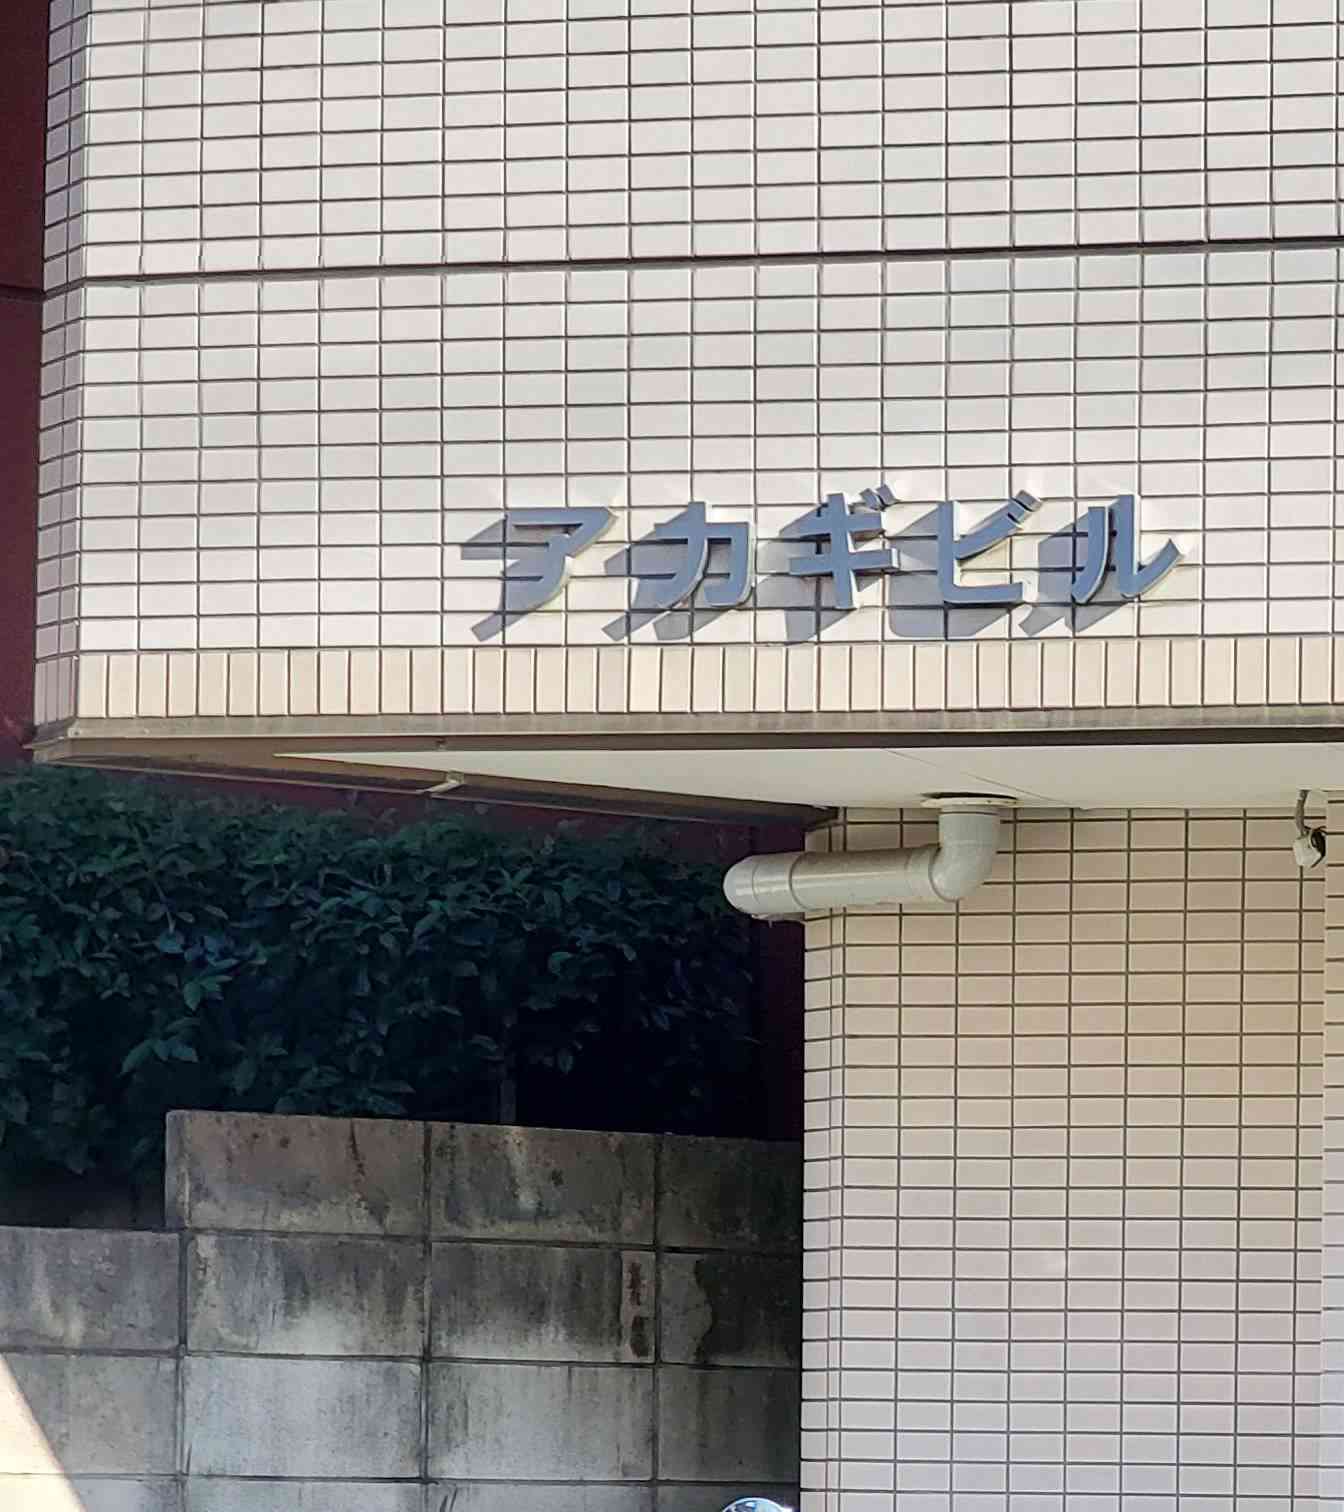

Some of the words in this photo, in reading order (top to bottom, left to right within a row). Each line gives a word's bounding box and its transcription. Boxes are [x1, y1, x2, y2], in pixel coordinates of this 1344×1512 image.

[503, 484, 1184, 611] アカギビル
